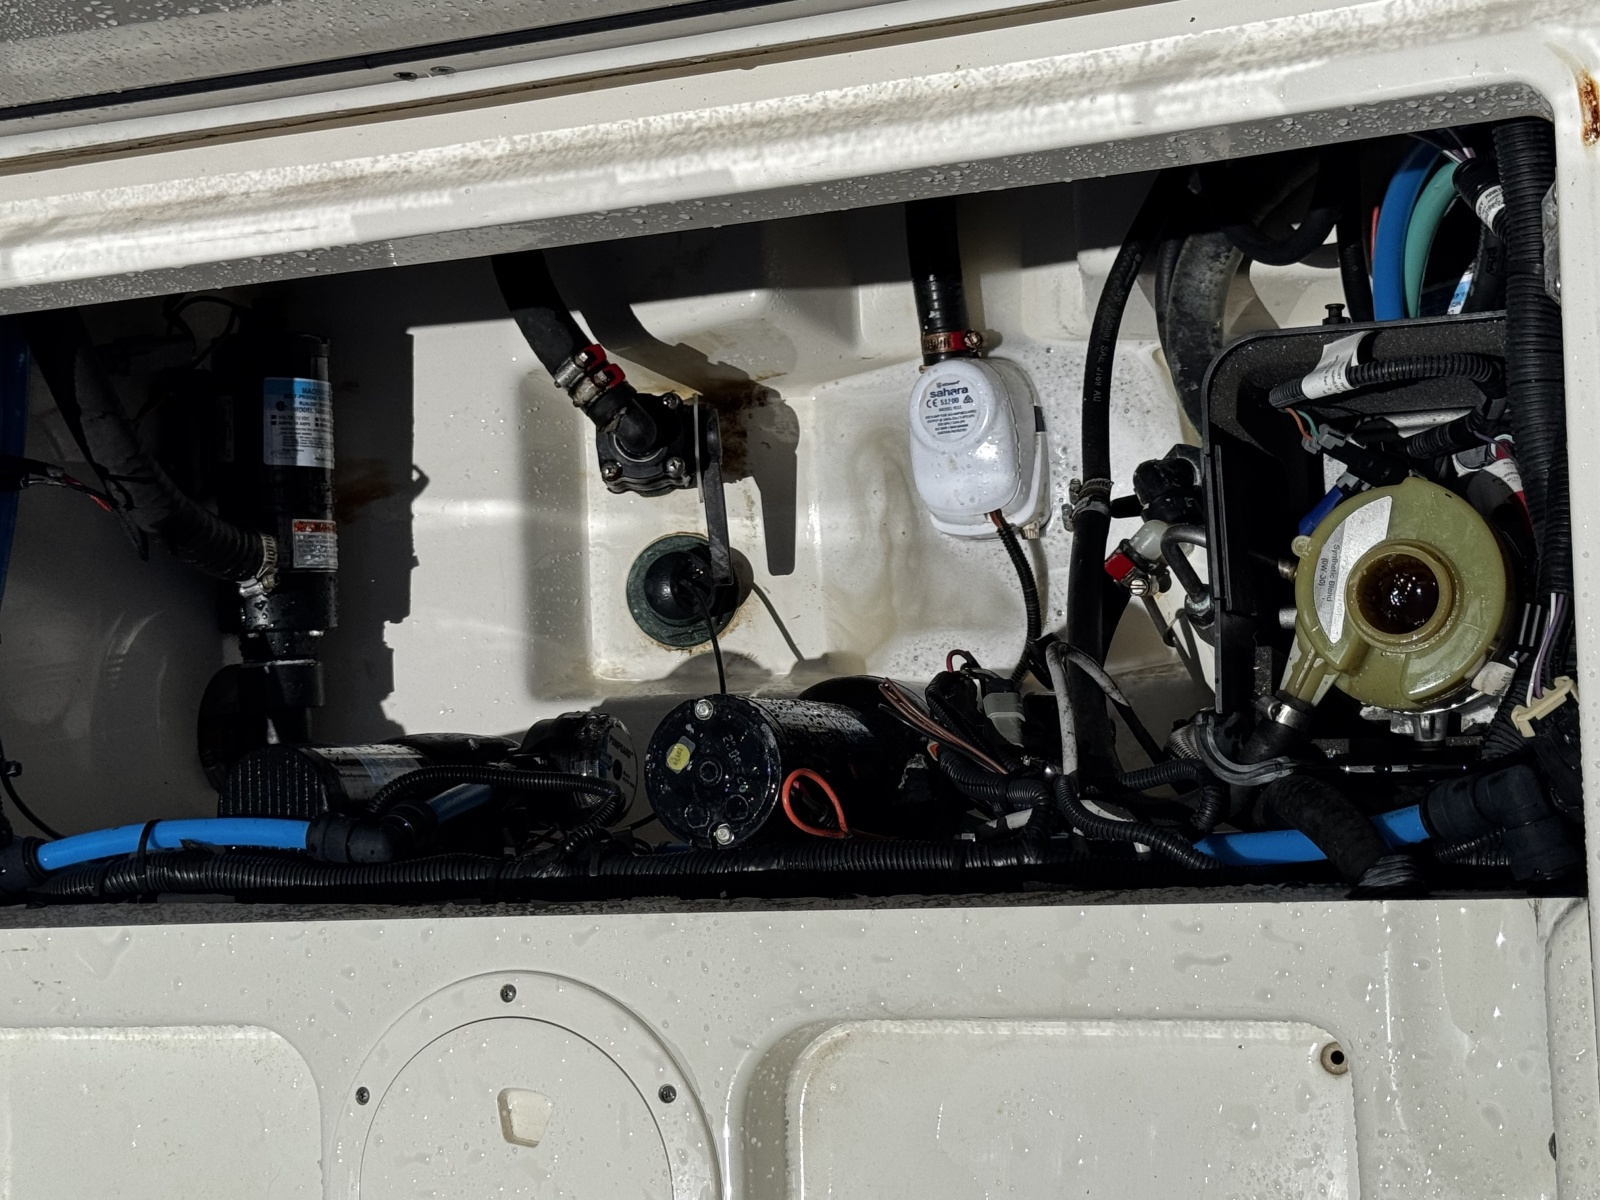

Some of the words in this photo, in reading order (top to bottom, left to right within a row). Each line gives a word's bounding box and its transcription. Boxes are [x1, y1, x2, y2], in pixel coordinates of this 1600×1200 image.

[930, 387, 968, 398] sahara
[1092, 391, 1102, 402] AU
[1318, 557, 1328, 587] (0W-30)
[1329, 544, 1340, 579] Synthetic
[1326, 581, 1335, 602] Blend
